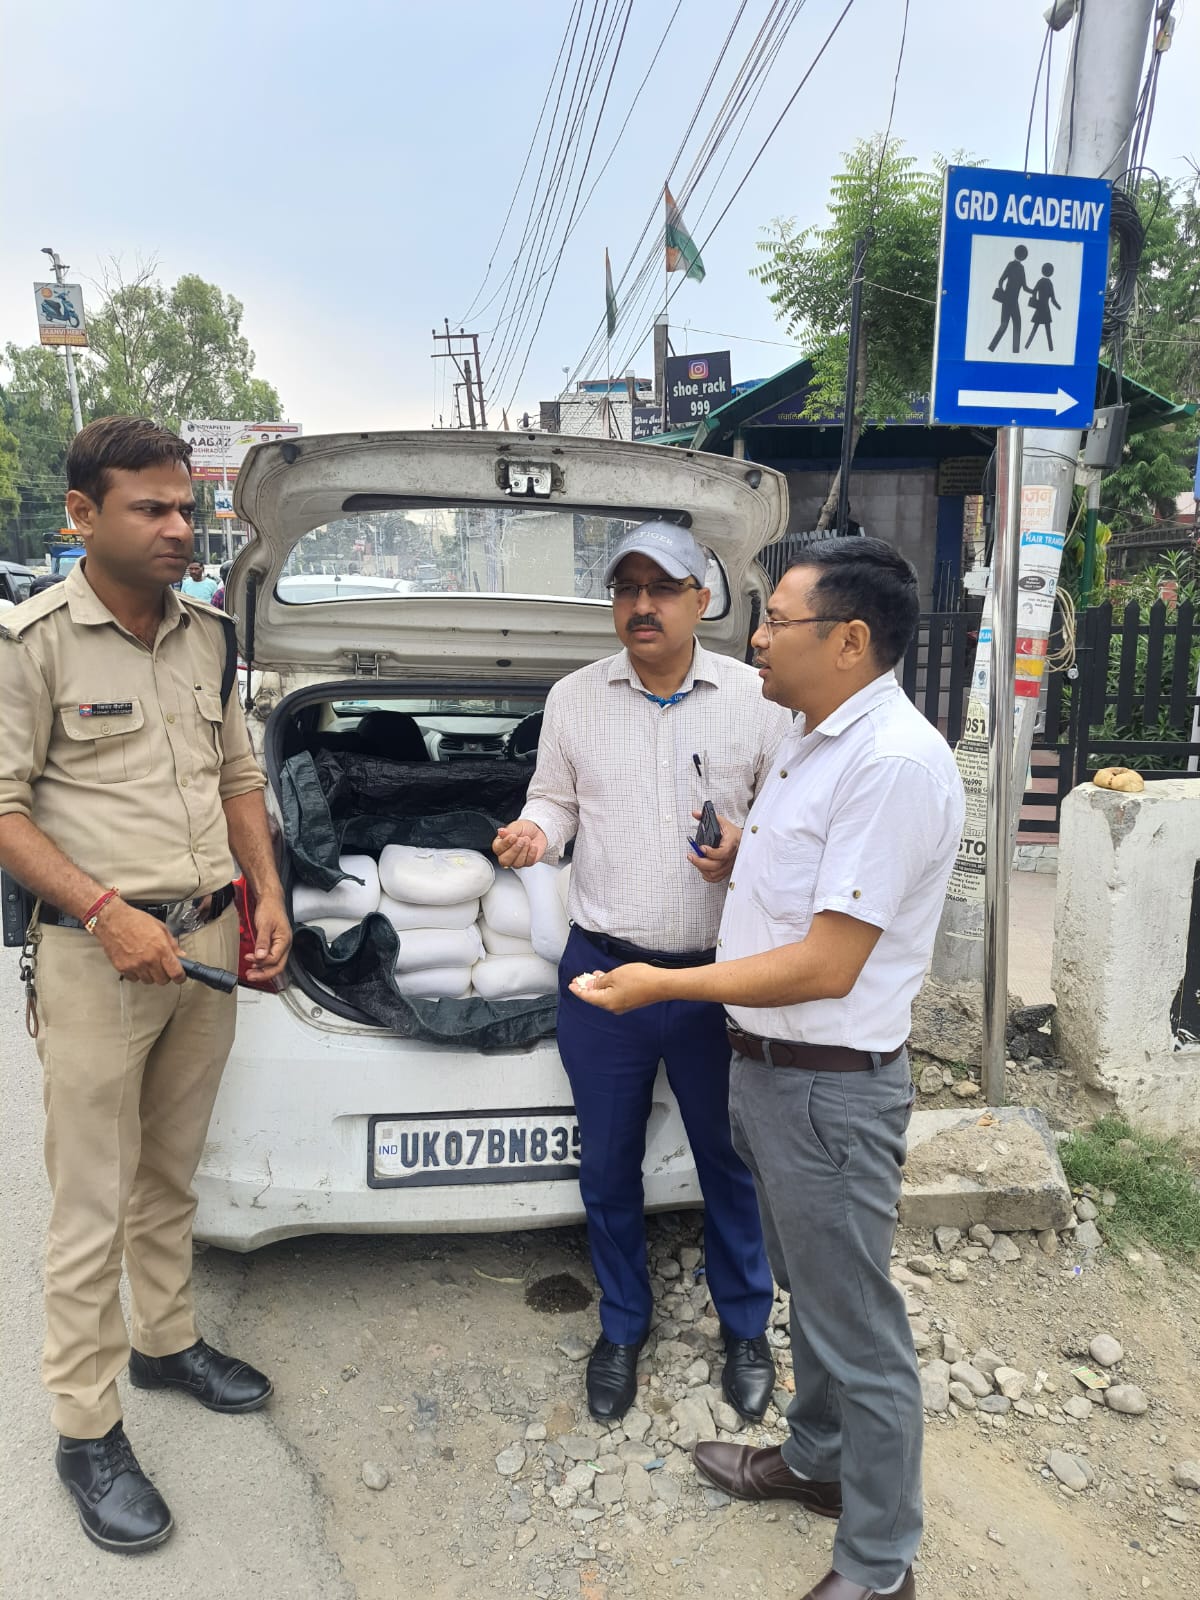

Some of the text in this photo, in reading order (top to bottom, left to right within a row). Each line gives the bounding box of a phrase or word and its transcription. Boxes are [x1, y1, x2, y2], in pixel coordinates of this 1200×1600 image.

[954, 188, 1105, 231] GRD ACADEMY
[673, 376, 726, 398] shoe_rack
[690, 399, 711, 417] 999
[379, 1144, 398, 1155] IND
